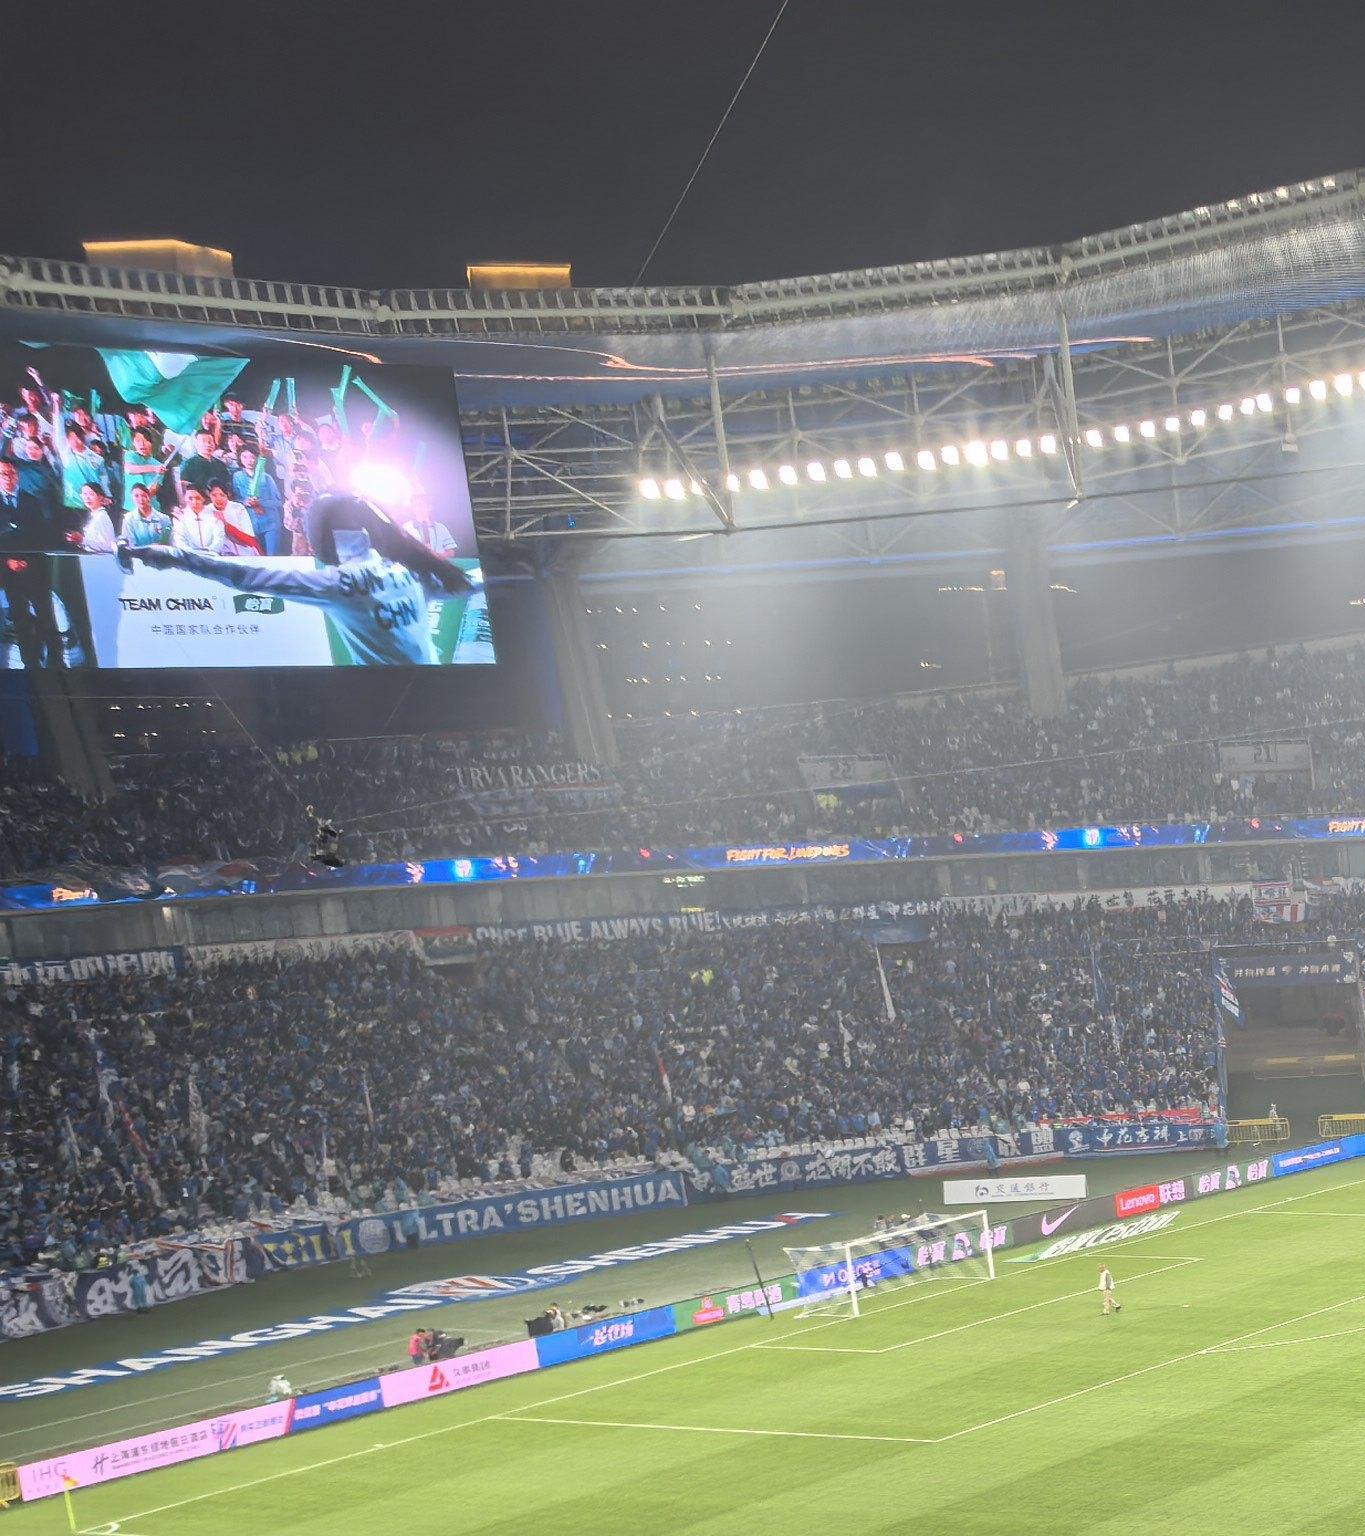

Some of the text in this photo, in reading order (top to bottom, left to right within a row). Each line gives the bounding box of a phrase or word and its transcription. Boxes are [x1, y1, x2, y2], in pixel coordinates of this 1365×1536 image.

[118, 597, 214, 611] TEAM CHINA
[374, 598, 418, 630] CHN
[589, 915, 664, 940] ALWAYS
[1119, 1191, 1155, 1211] Lenovo
